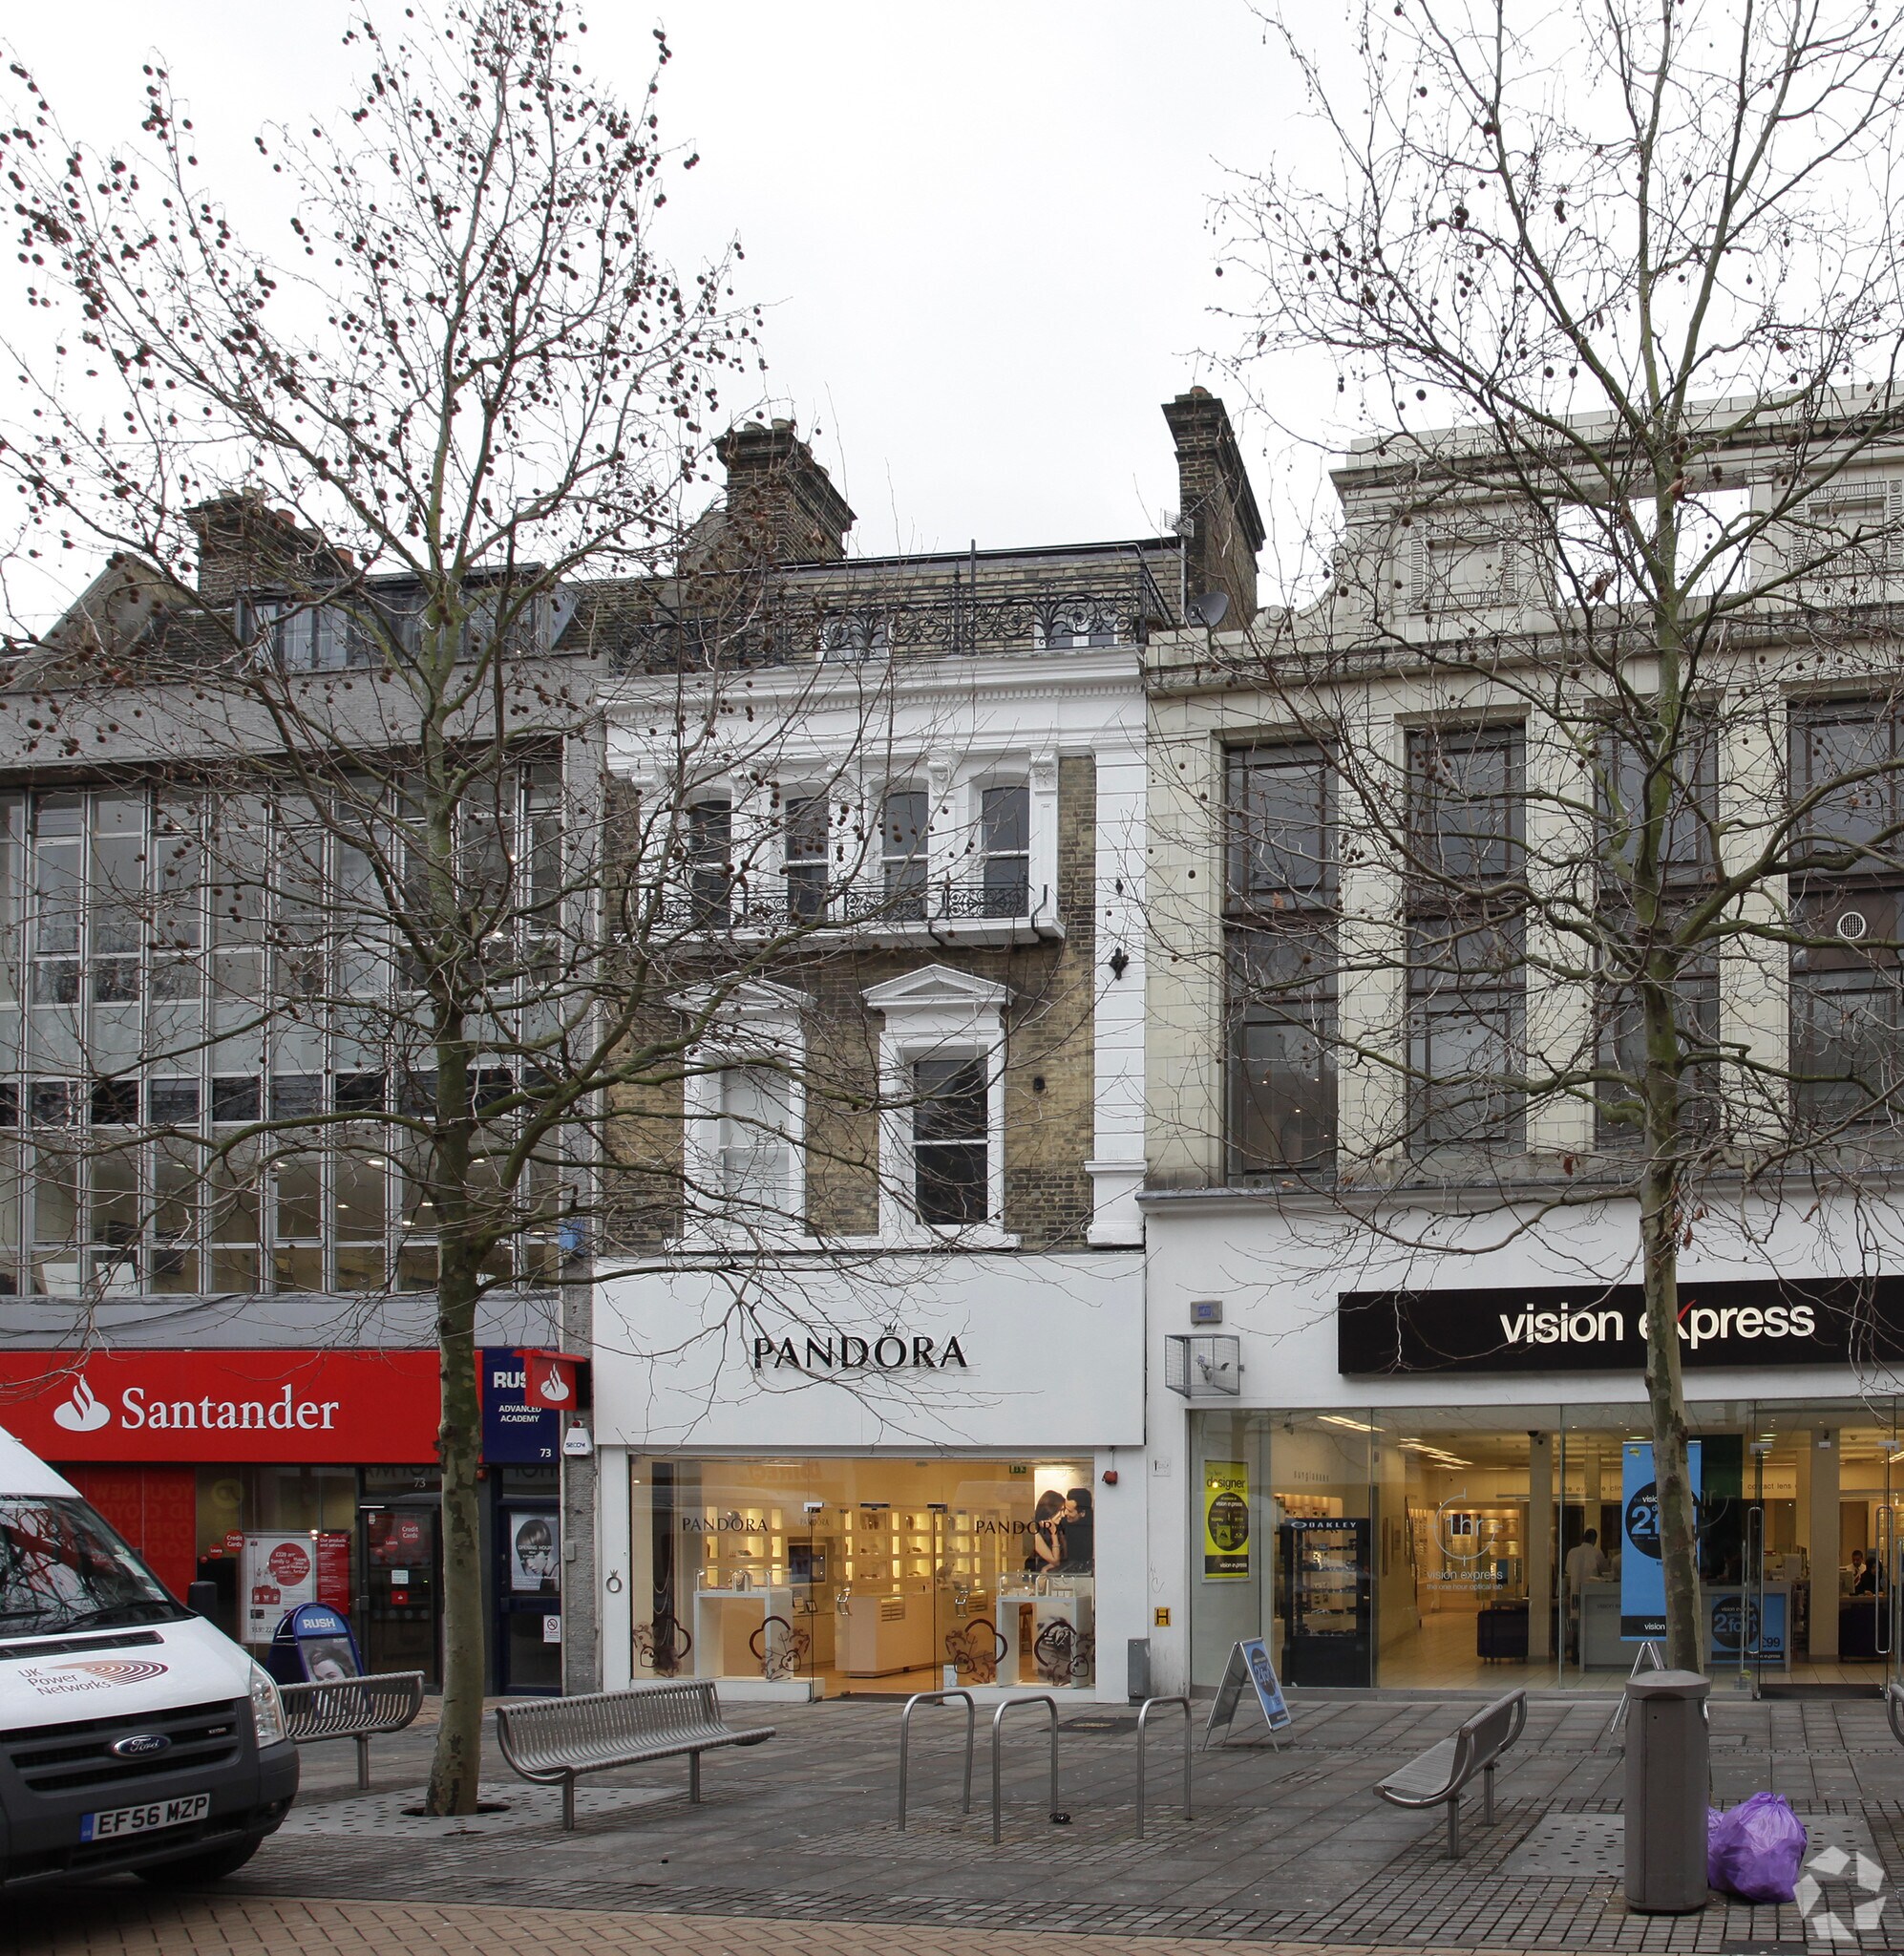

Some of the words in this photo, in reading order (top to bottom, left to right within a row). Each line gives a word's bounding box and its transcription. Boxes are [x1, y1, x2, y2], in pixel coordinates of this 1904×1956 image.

[1500, 1303, 1624, 1344] vision
[753, 1335, 968, 1369] PANDORA
[494, 1371, 527, 1389] RUS
[121, 1383, 339, 1430] Santander
[500, 1414, 539, 1423] ACADEMY
[539, 1448, 552, 1457] 73
[413, 1478, 427, 1488] 73
[1642, 1495, 1659, 1503] visio
[682, 1517, 769, 1532] PANDORA
[976, 1520, 1066, 1535] PANDORA
[1445, 1514, 1484, 1536] 1hr
[1428, 1571, 1457, 1581] vision
[1460, 1571, 1503, 1582] express
[303, 1618, 336, 1628] RUSH
[1156, 1608, 1169, 1625] H
[17, 1668, 43, 1678] UK
[28, 1673, 78, 1688] Power
[37, 1679, 112, 1696] Networks
[130, 1737, 160, 1752] Ford
[97, 1805, 161, 1835] EF56
[166, 1797, 208, 1823] MZP
